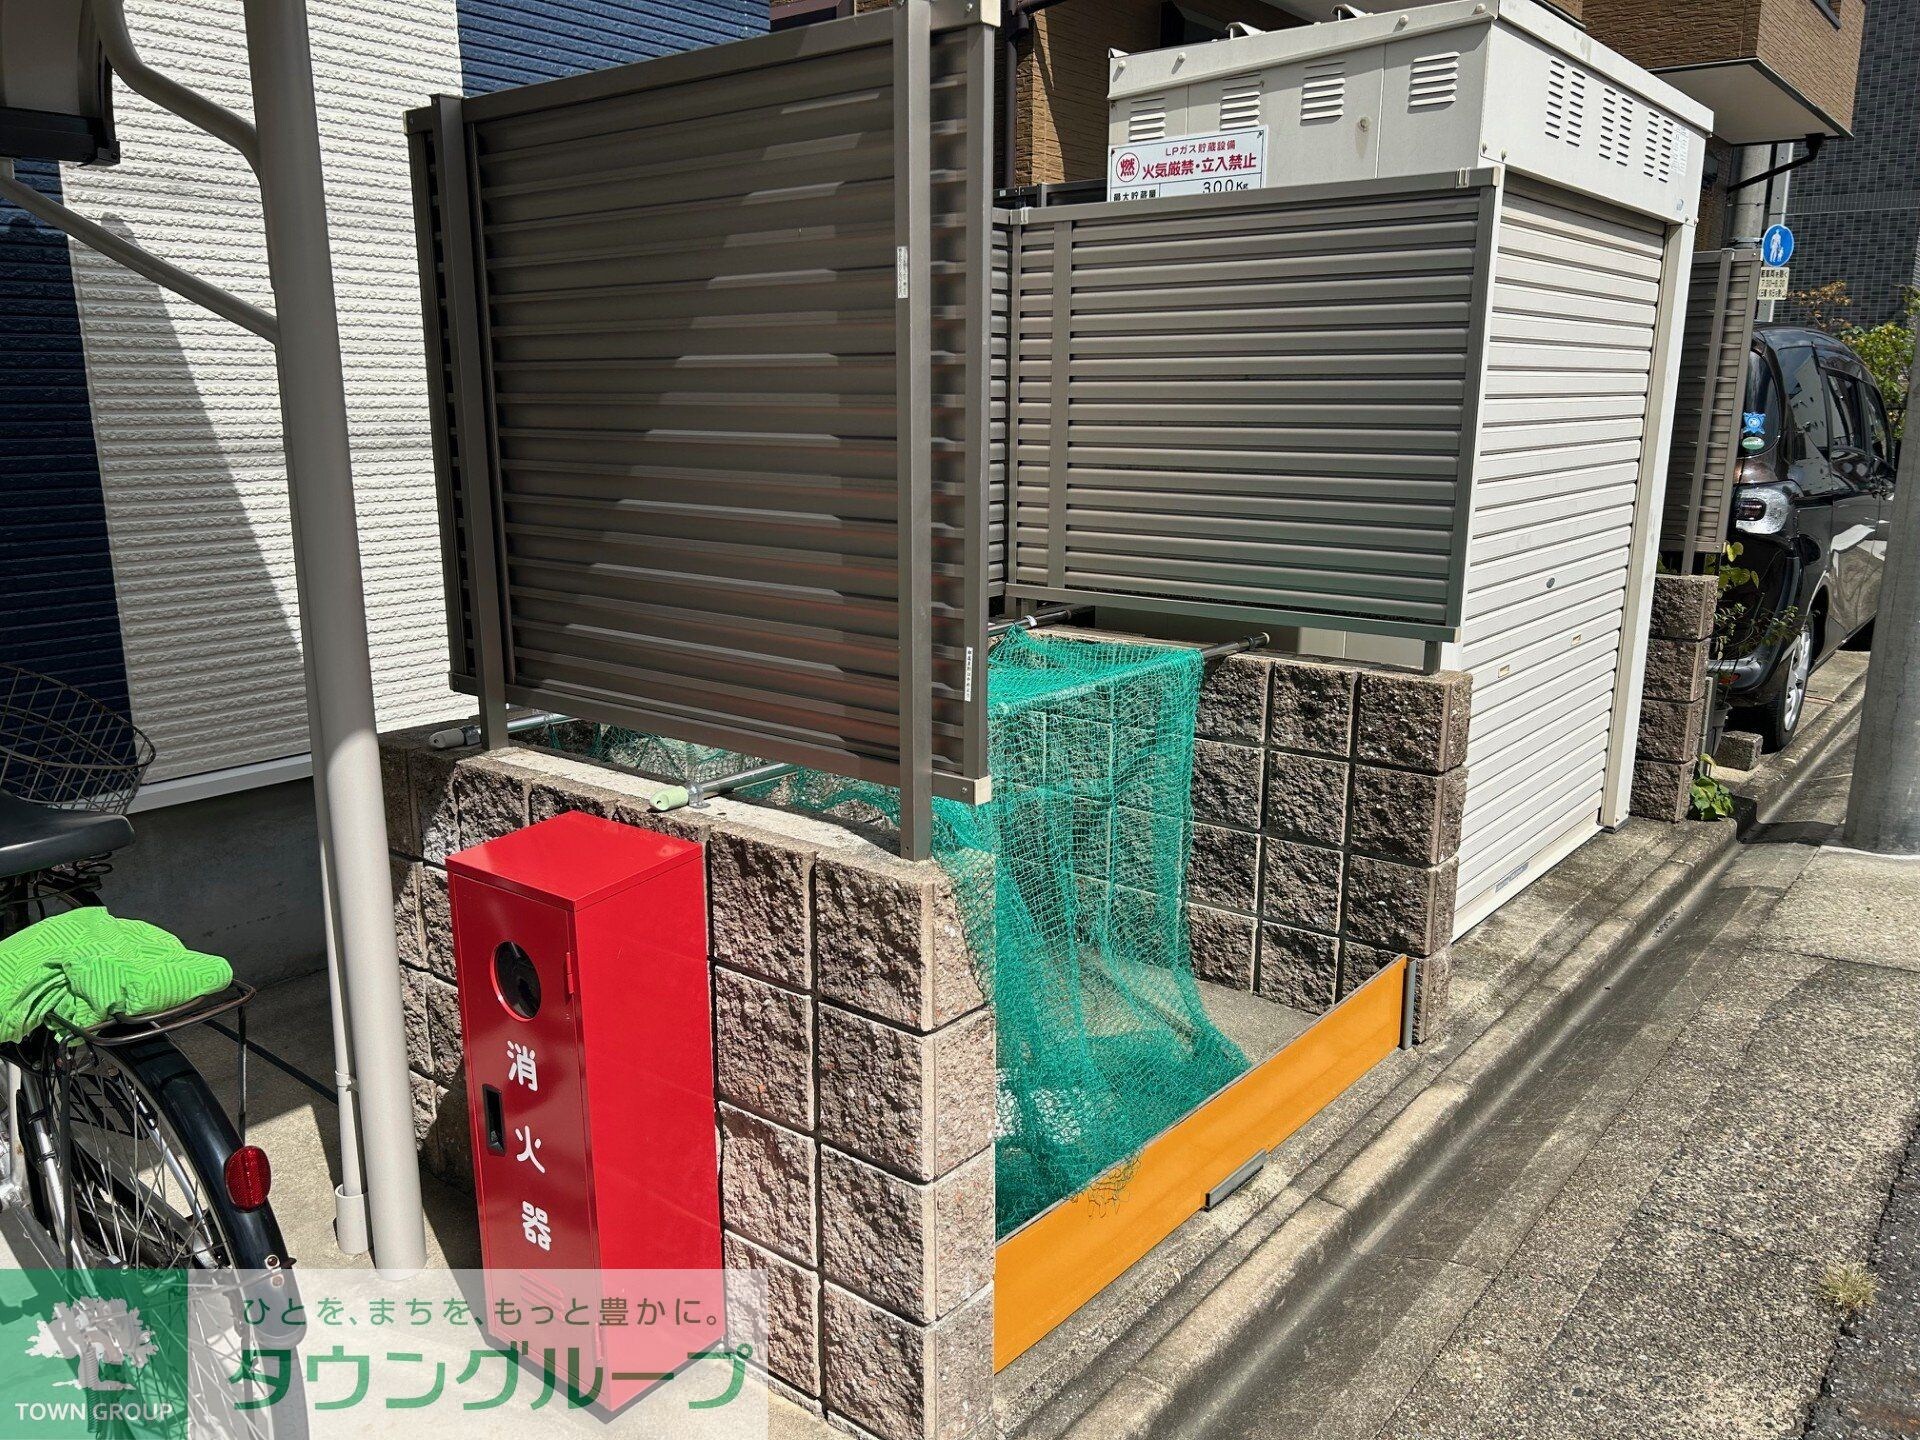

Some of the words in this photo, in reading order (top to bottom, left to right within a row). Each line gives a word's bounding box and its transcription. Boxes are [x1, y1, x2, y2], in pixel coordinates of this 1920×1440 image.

[1165, 140, 1236, 157] LPガス貯蔵設備
[1120, 158, 1135, 177] 燃
[1142, 153, 1257, 180] 火気厳禁・立入禁止
[506, 1040, 551, 1251] 消火器
